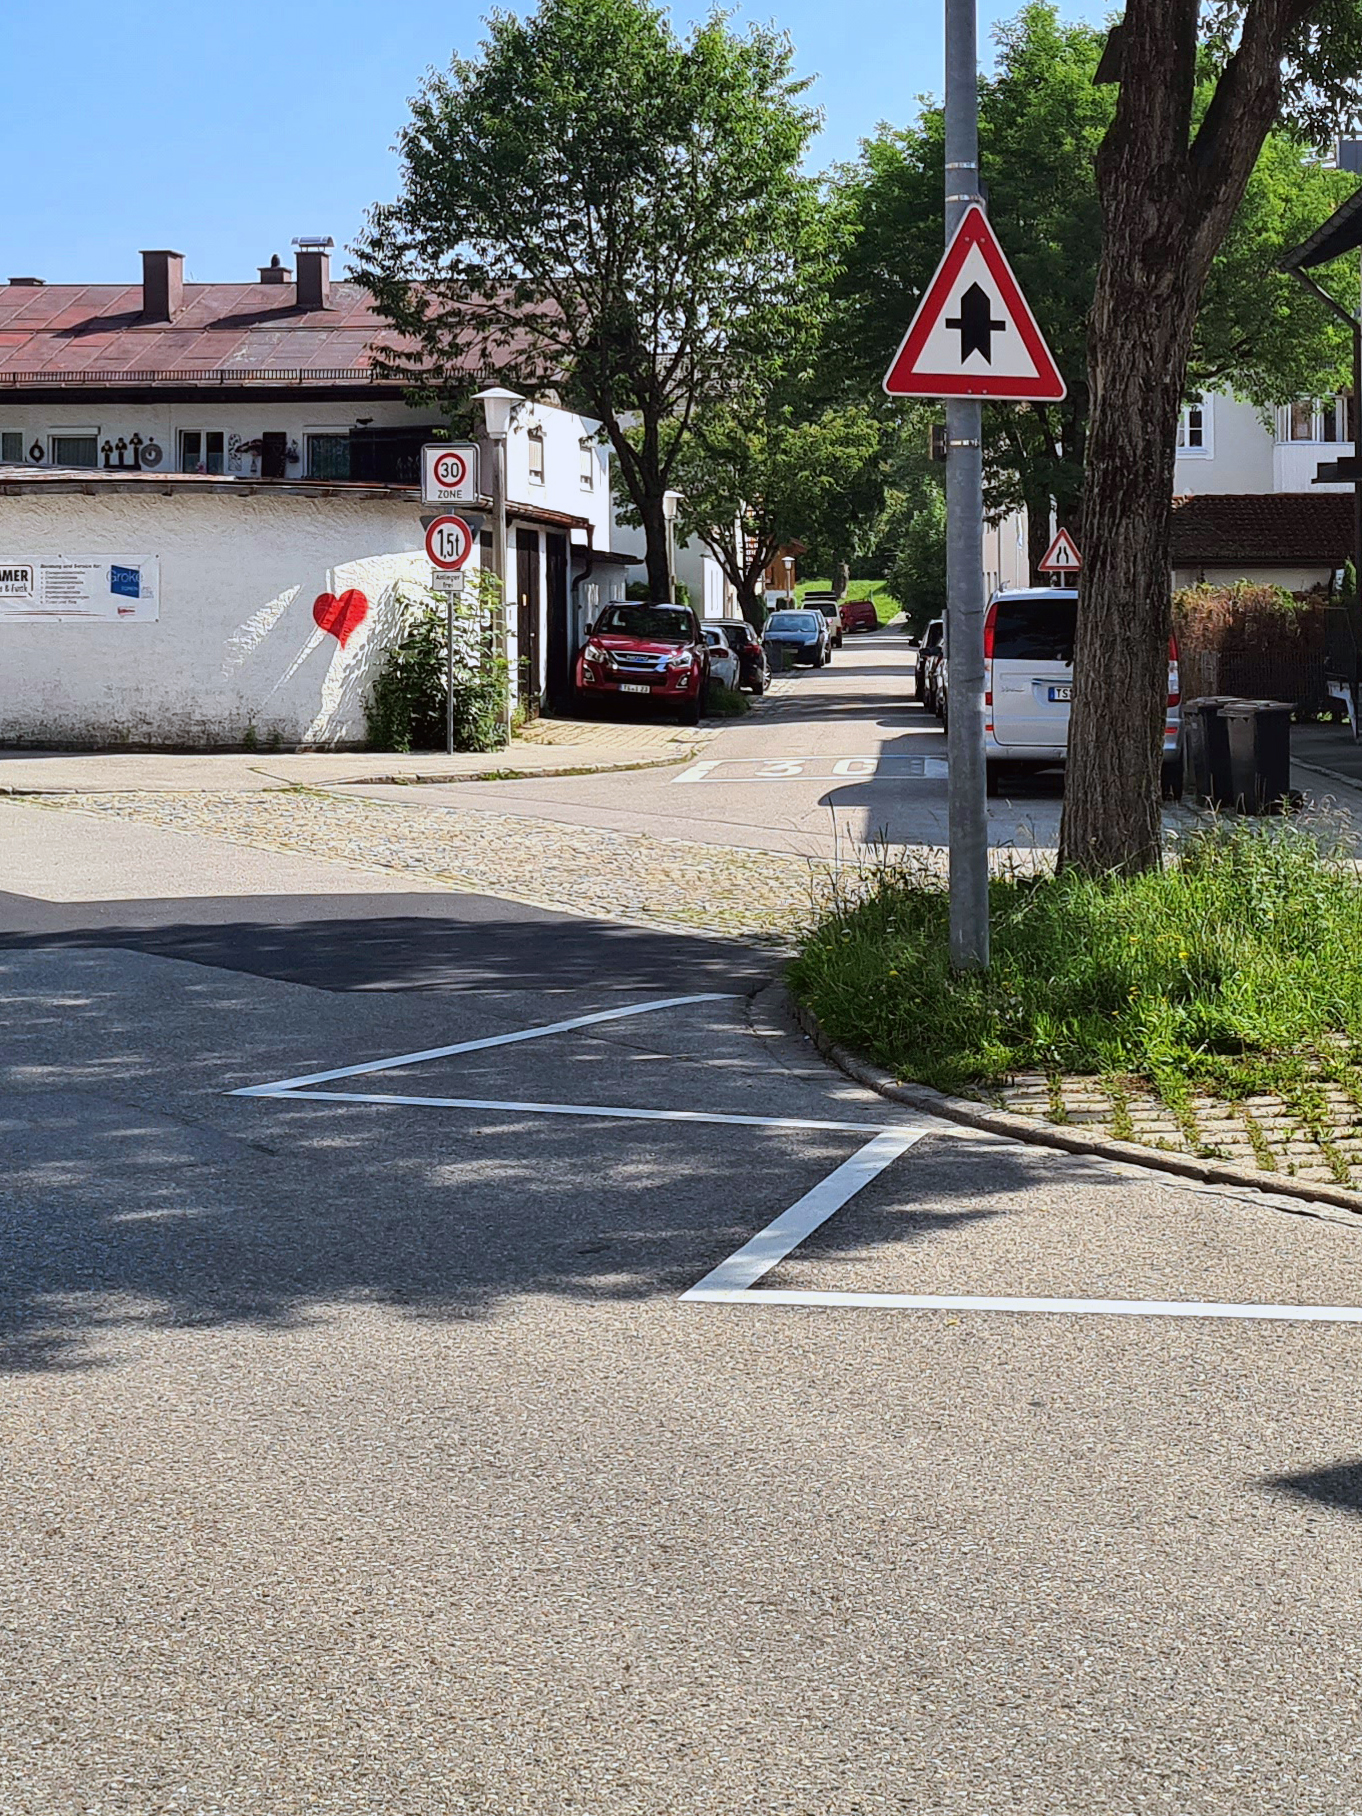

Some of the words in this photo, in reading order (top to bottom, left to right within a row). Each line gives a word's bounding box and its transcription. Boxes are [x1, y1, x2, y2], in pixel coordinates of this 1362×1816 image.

[440, 462, 460, 479] 30
[437, 489, 463, 499] ZONE
[436, 528, 460, 559] 1,5t
[106, 570, 144, 583] Groke
